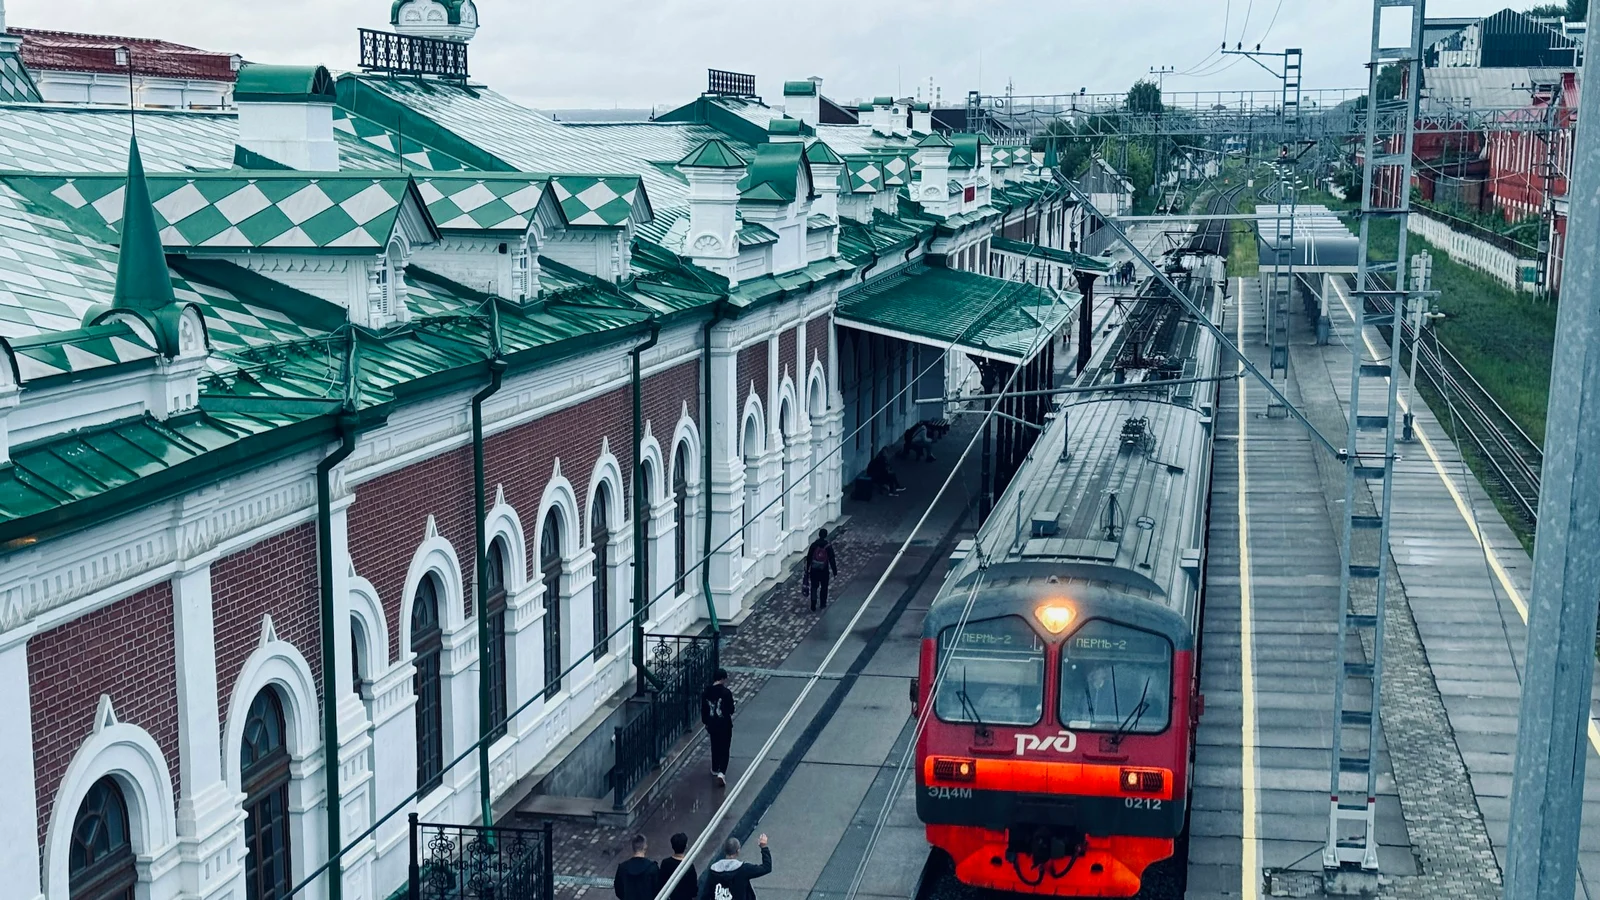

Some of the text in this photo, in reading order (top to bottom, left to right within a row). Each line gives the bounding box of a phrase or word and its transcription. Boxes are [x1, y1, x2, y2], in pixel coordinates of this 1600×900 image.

[961, 633, 1012, 644] ПЕРМЬ-2
[1076, 638, 1127, 649] ПЕРМЬ-2
[927, 786, 973, 799] ЭД4М
[1124, 797, 1162, 810] 0212
